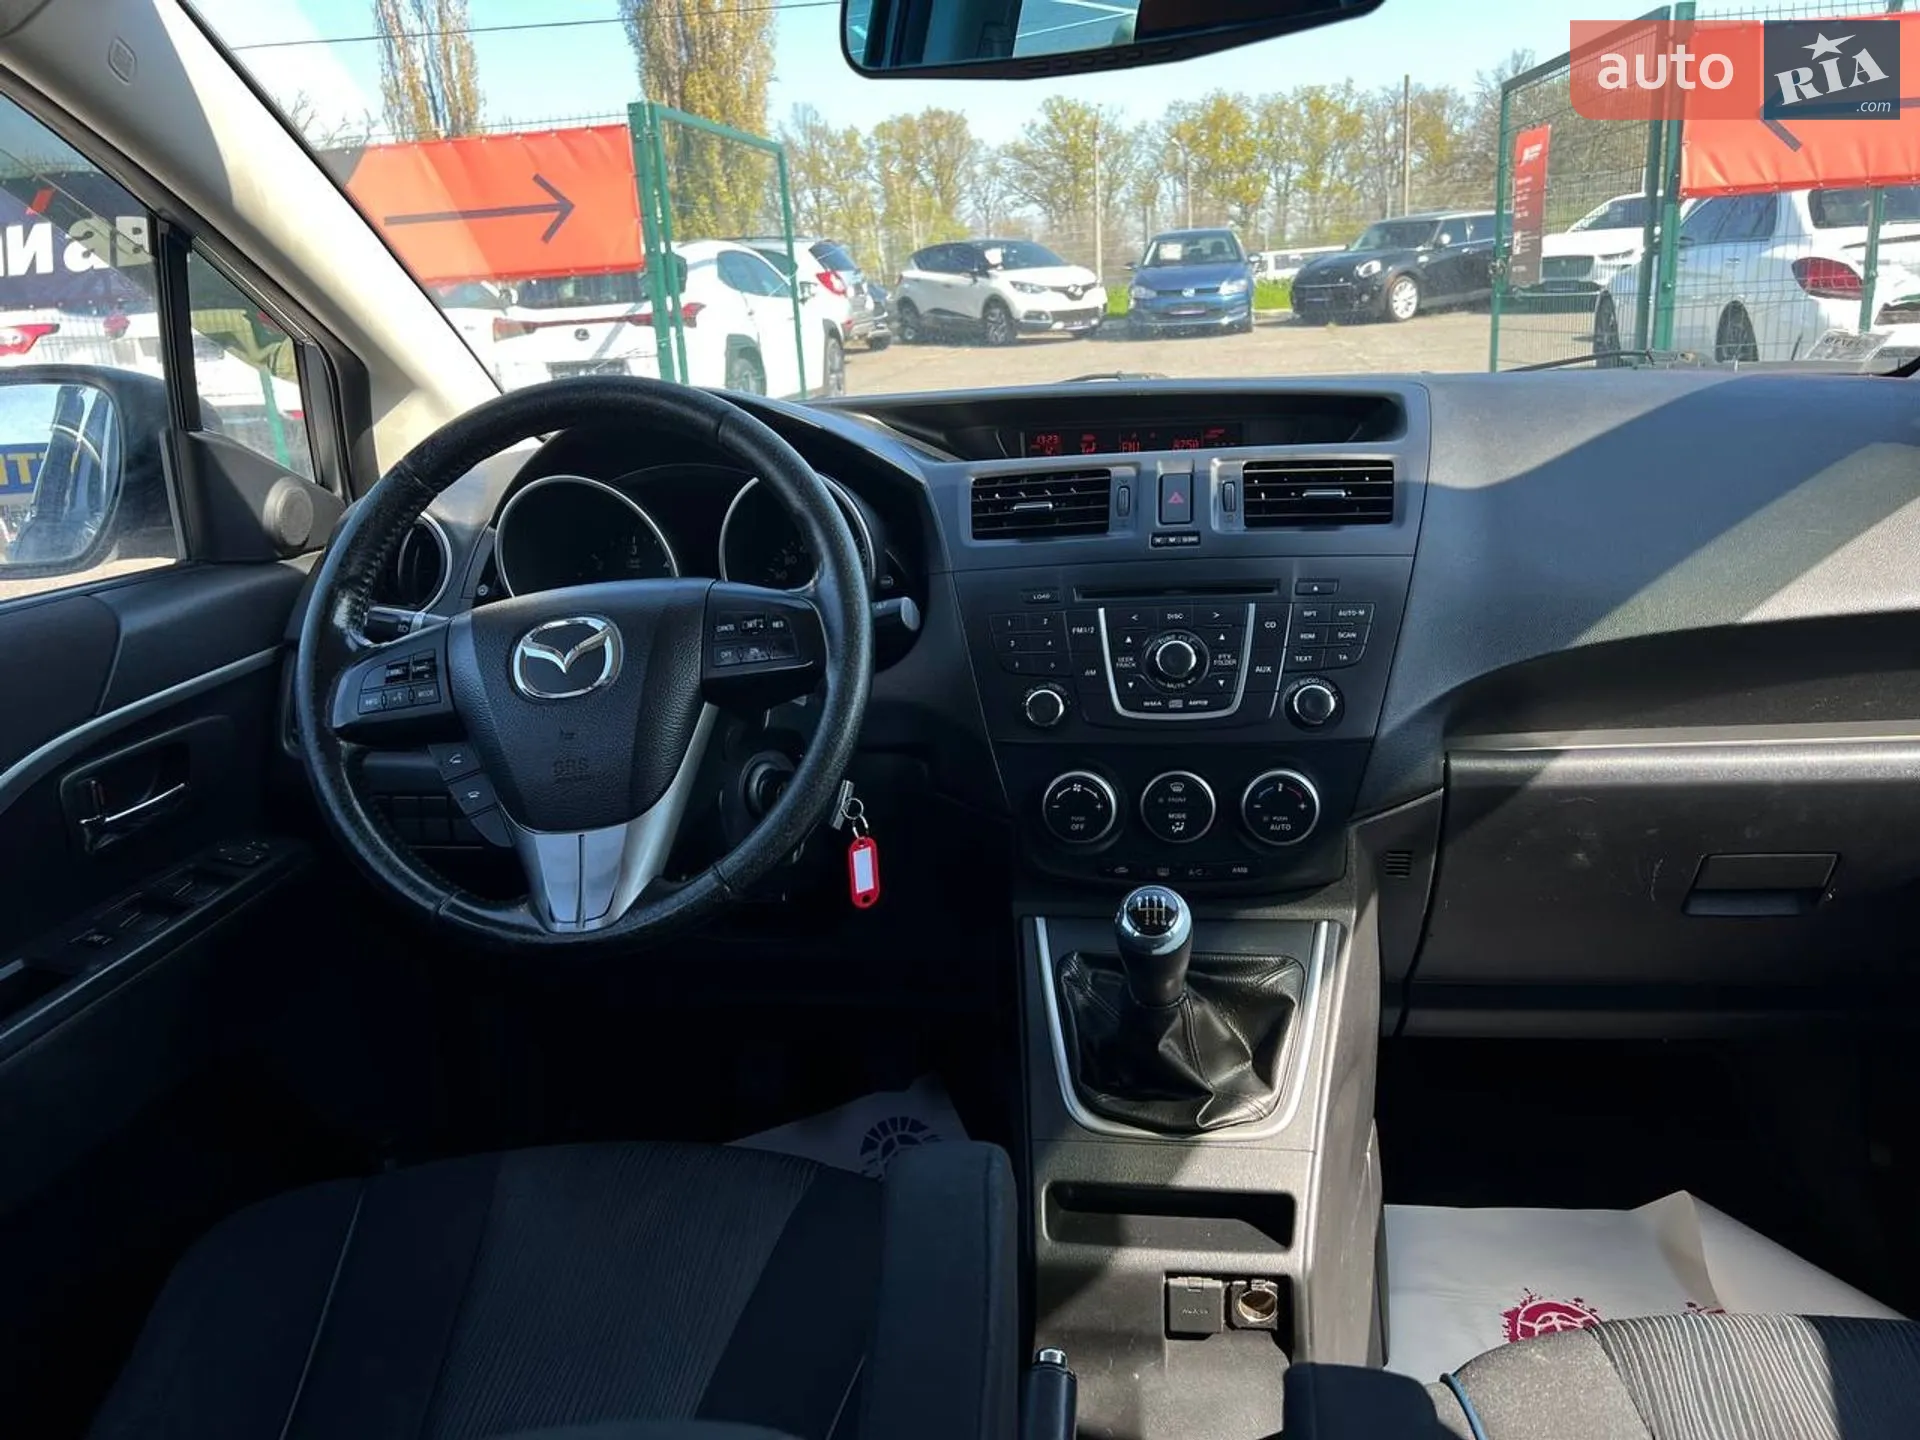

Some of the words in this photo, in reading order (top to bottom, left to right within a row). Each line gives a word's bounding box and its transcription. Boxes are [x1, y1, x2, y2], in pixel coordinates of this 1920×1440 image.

[1264, 621, 1277, 629] CD
[1072, 626, 1095, 635] FM1/2
[1338, 631, 1357, 639] SCAN
[1255, 666, 1272, 674] AUX
[1071, 823, 1085, 831] OFF
[1270, 823, 1291, 831] AUTO
